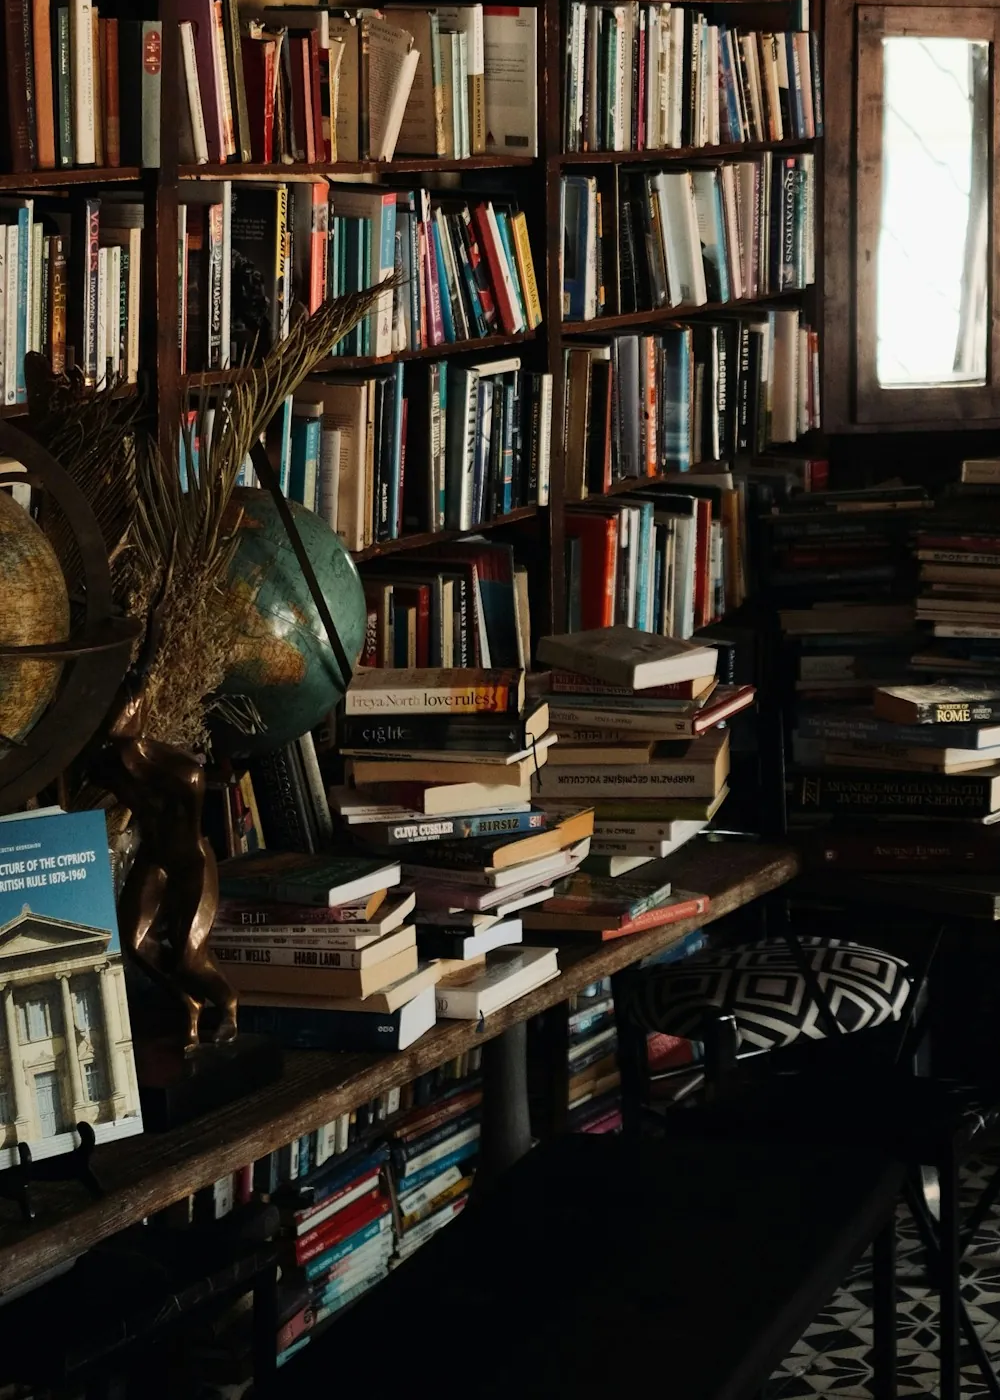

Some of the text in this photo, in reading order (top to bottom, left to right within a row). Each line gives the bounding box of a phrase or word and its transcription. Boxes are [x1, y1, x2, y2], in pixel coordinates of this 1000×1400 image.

[783, 170, 794, 262] QUOTATIONS
[89, 209, 99, 272] VOICES
[524, 262, 538, 309] RUSSIAN
[718, 352, 726, 411] McCORMACK
[937, 709, 971, 722] ROME
[394, 821, 454, 839] CLIVE CUSSLER
[479, 818, 520, 832] HIRSIZ
[27, 861, 39, 872] OF
[39, 857, 56, 870] THE
[57, 850, 97, 867] CYPRIOTS
[27, 874, 47, 889] RULE
[49, 868, 87, 885] 1878-1960
[245, 950, 341, 967] WELLS HARD LAND
